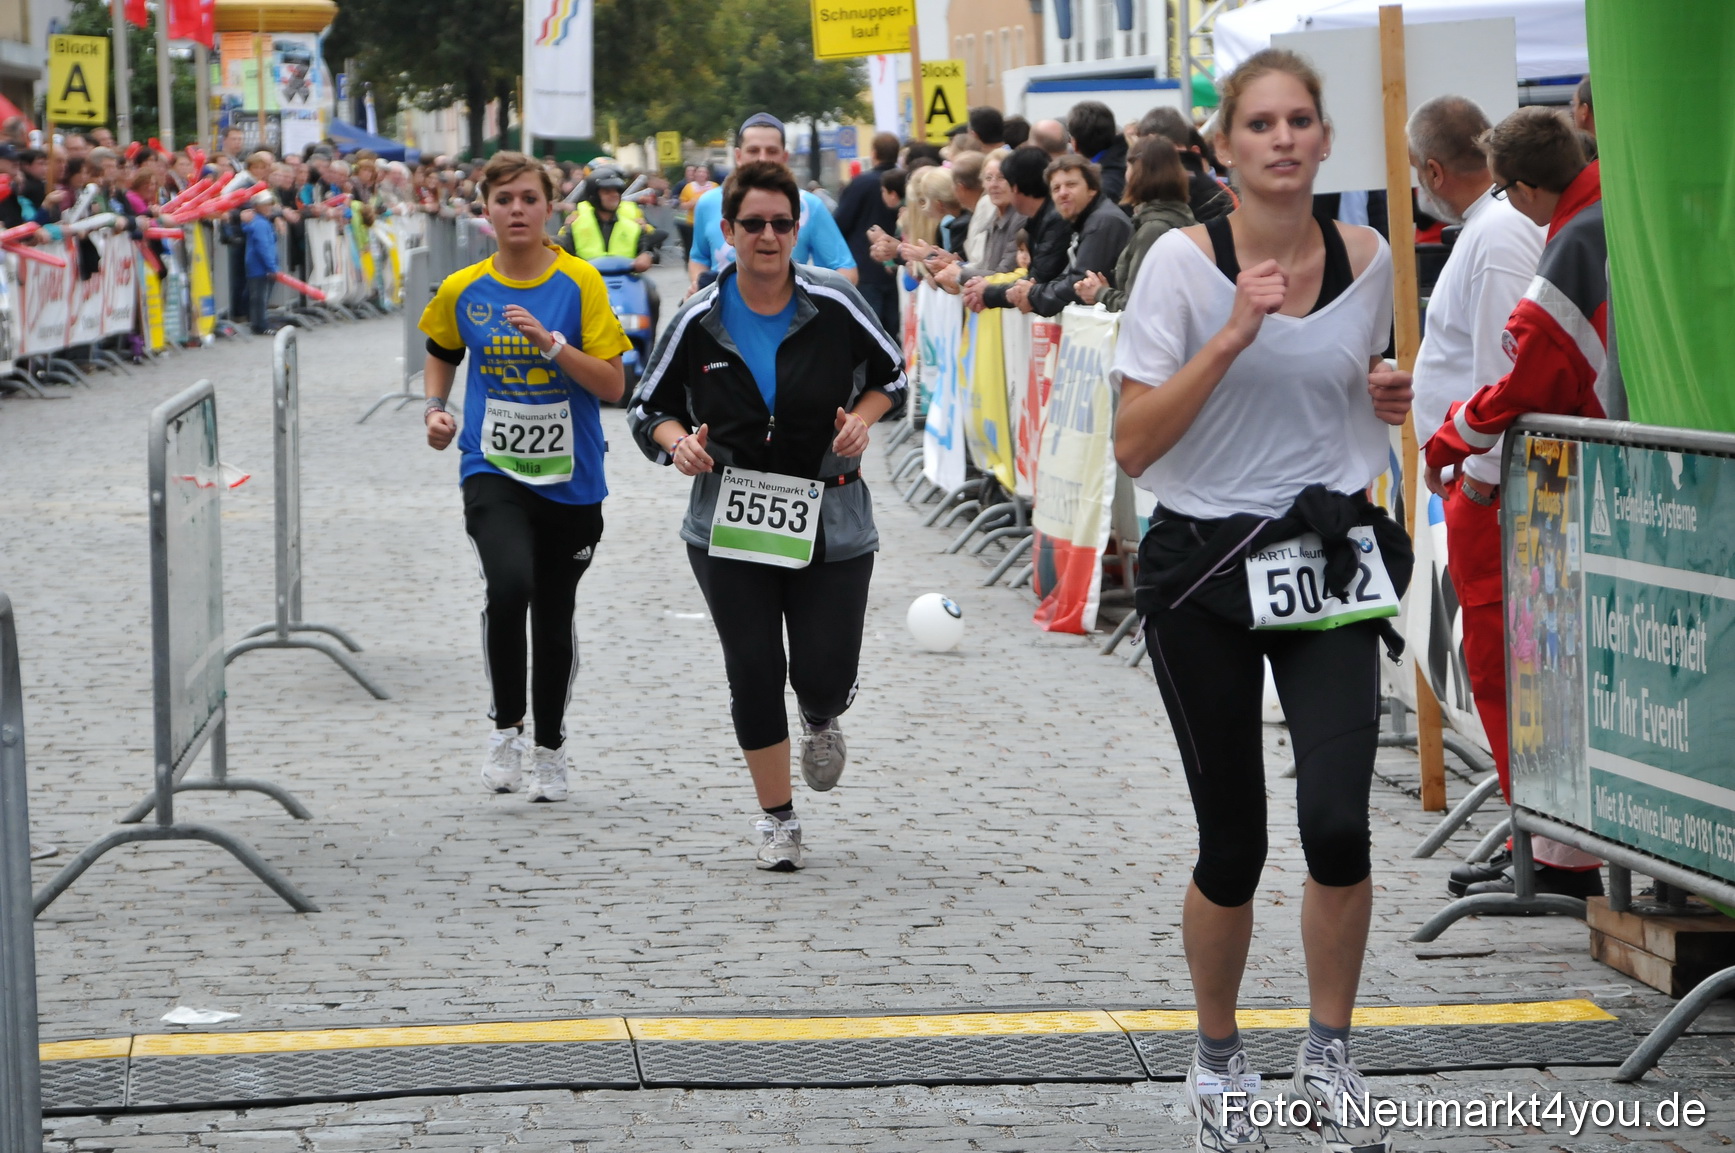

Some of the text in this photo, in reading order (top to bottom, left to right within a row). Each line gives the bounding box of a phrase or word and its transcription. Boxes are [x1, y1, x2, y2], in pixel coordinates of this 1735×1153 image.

[820, 5, 909, 22] Schnupper-
[851, 24, 880, 39] lauf
[54, 38, 99, 55] Block
[61, 62, 92, 102] A
[926, 85, 955, 124] A
[487, 407, 557, 420] PARTL Neumarkt
[491, 421, 564, 453] 5222
[513, 461, 541, 474] Julia
[723, 475, 804, 496] PARTL Neumarkt
[726, 489, 809, 533] 5553
[1250, 546, 1325, 563] PARTL Neum
[1592, 595, 1707, 674] Mehr Sicherheit
[1593, 671, 1689, 753] für Ihr Event!
[1596, 784, 1616, 822] Miet
[1618, 791, 1626, 825] &
[1627, 794, 1658, 837] Service
[1660, 804, 1682, 845] Line:
[1684, 812, 1714, 855] 09181
